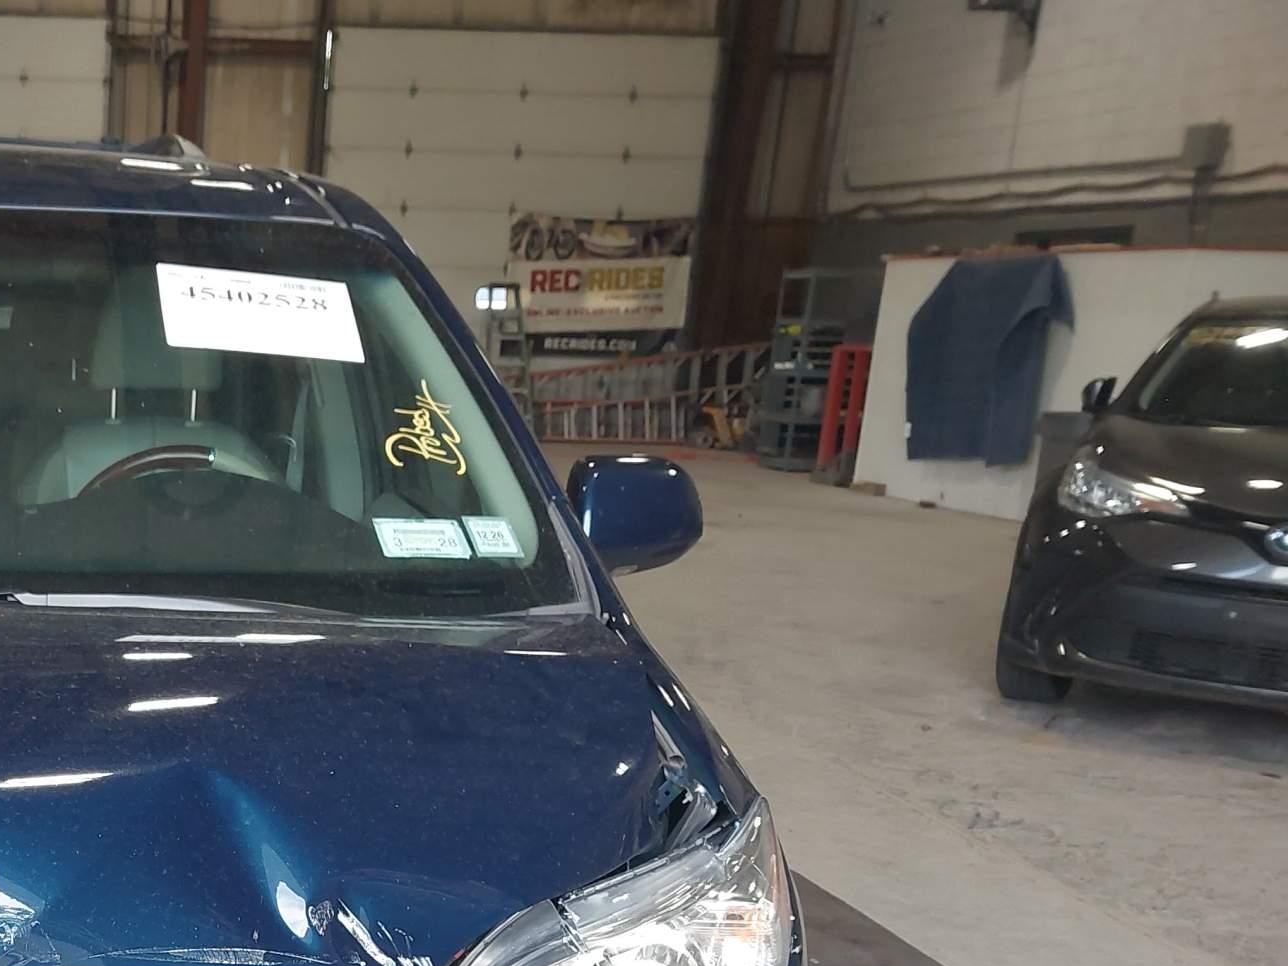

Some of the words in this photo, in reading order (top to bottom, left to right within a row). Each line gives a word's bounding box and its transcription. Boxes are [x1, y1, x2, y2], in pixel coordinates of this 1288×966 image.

[530, 269, 581, 293] REC
[587, 266, 665, 291] RIDES
[180, 285, 328, 312] 45402528
